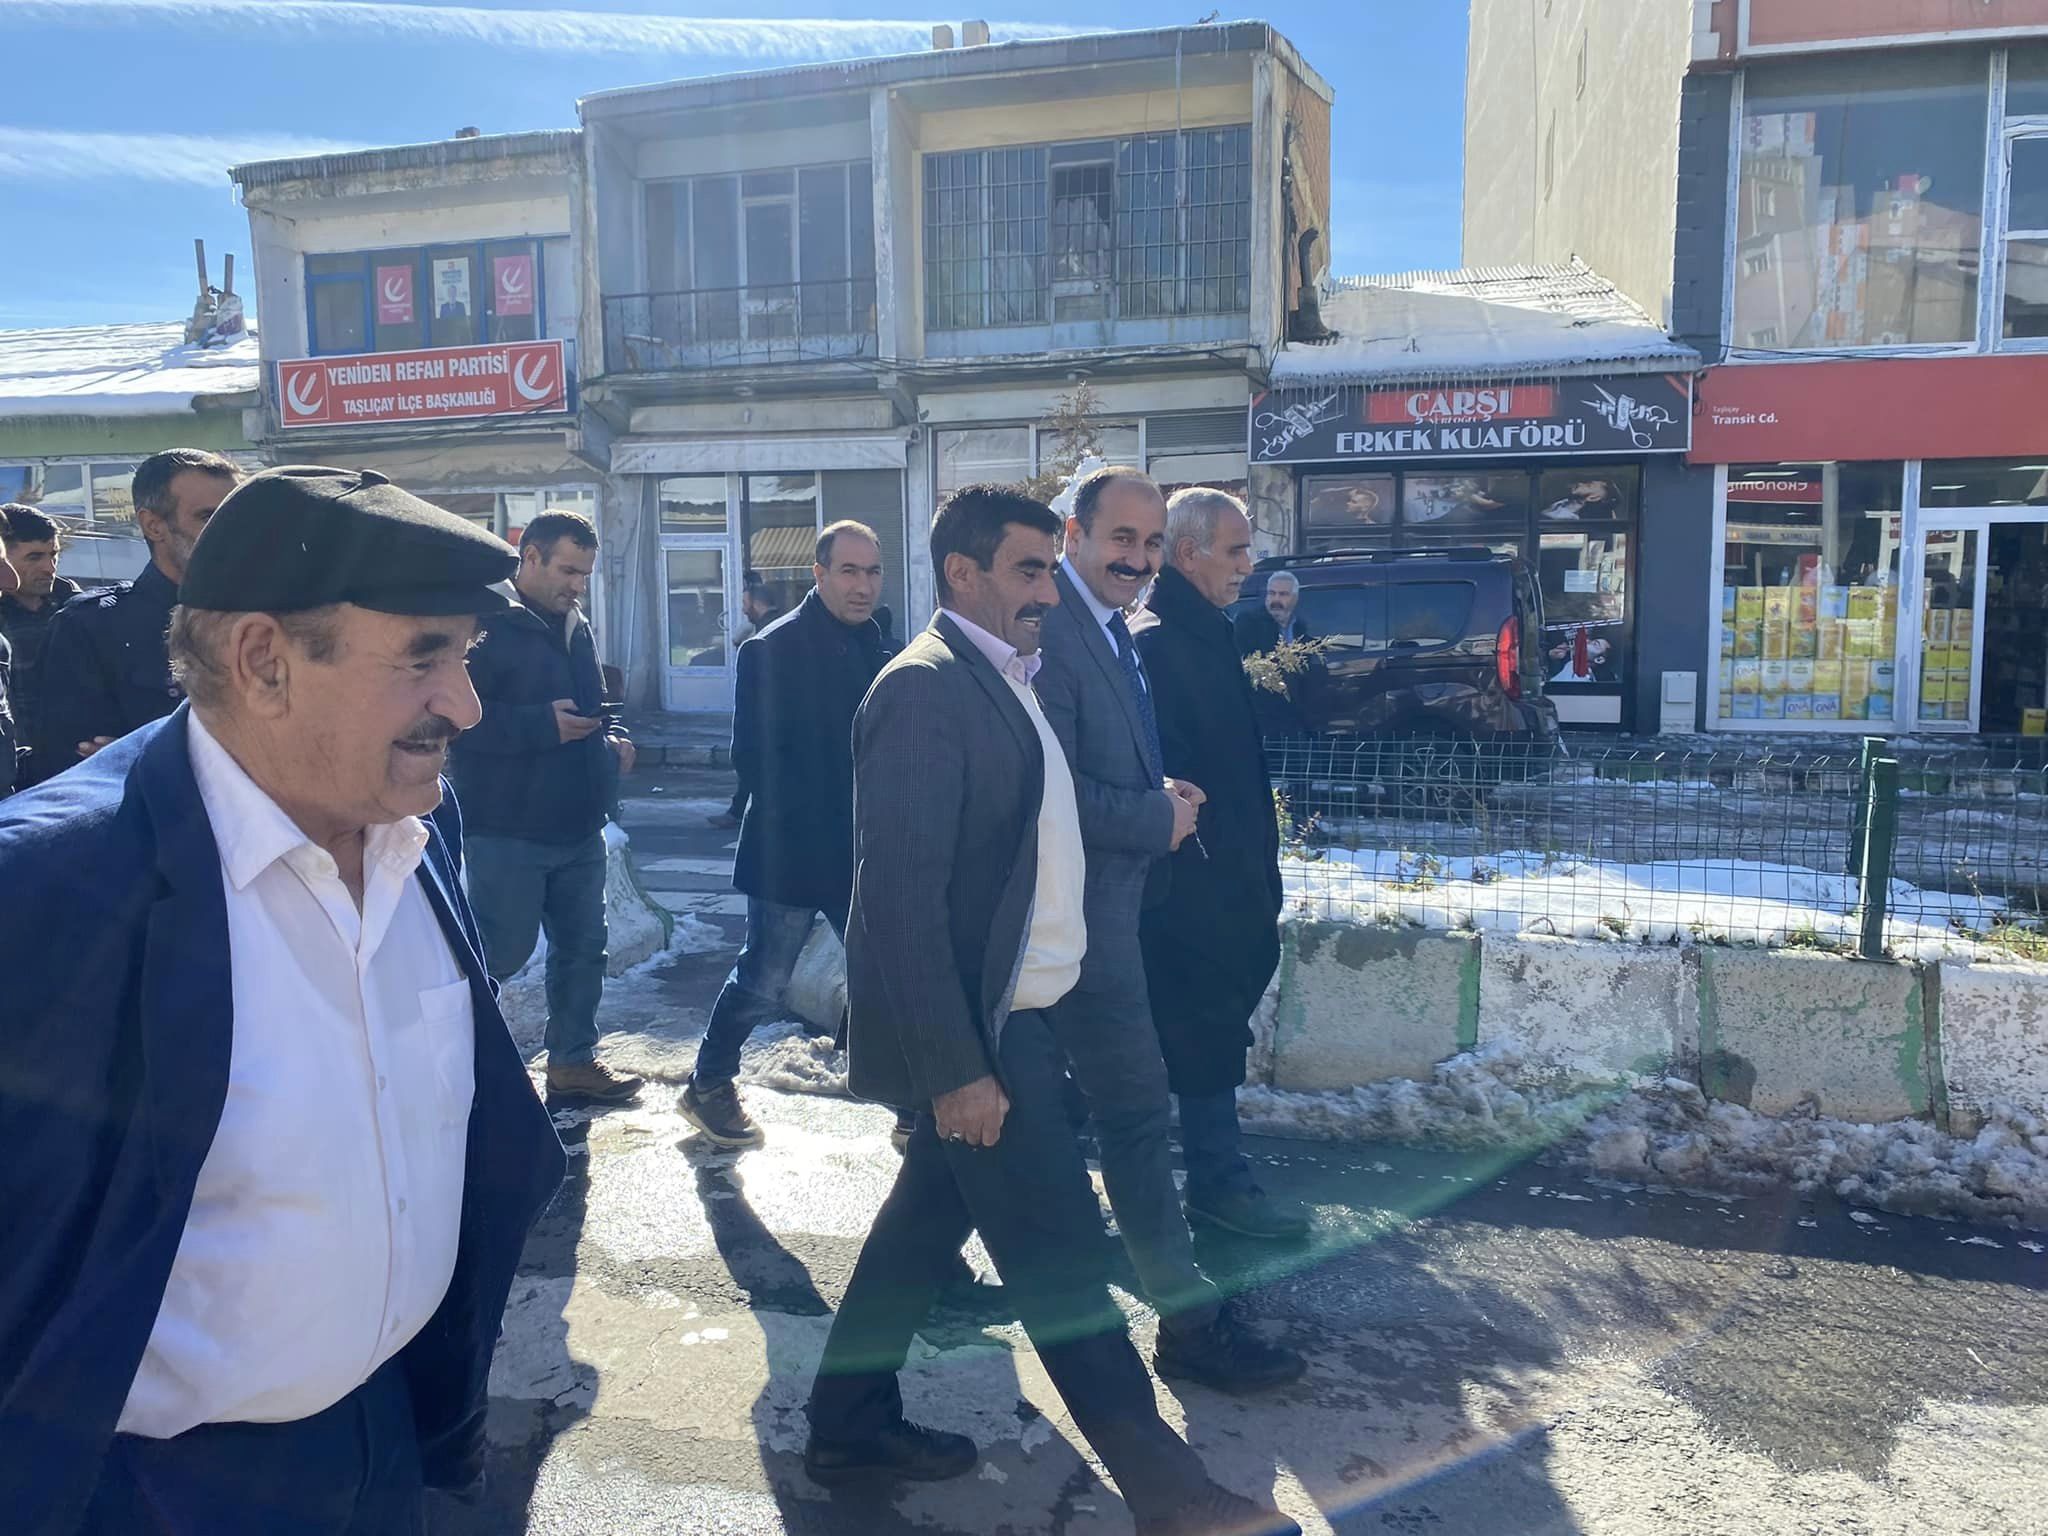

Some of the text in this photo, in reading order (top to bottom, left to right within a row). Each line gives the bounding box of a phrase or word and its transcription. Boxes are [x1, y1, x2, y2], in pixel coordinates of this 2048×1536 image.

[327, 350, 508, 386] YENİDEN REFAH PARTİSİ
[343, 386, 496, 417] TAŞLIÇAY İLÇE BAŞKANLIĞI
[1407, 389, 1511, 425] ÇARŞI
[1712, 412, 1779, 424] Transit Cd.
[1335, 418, 1585, 454] ERKEK KUAFÖRÜ
